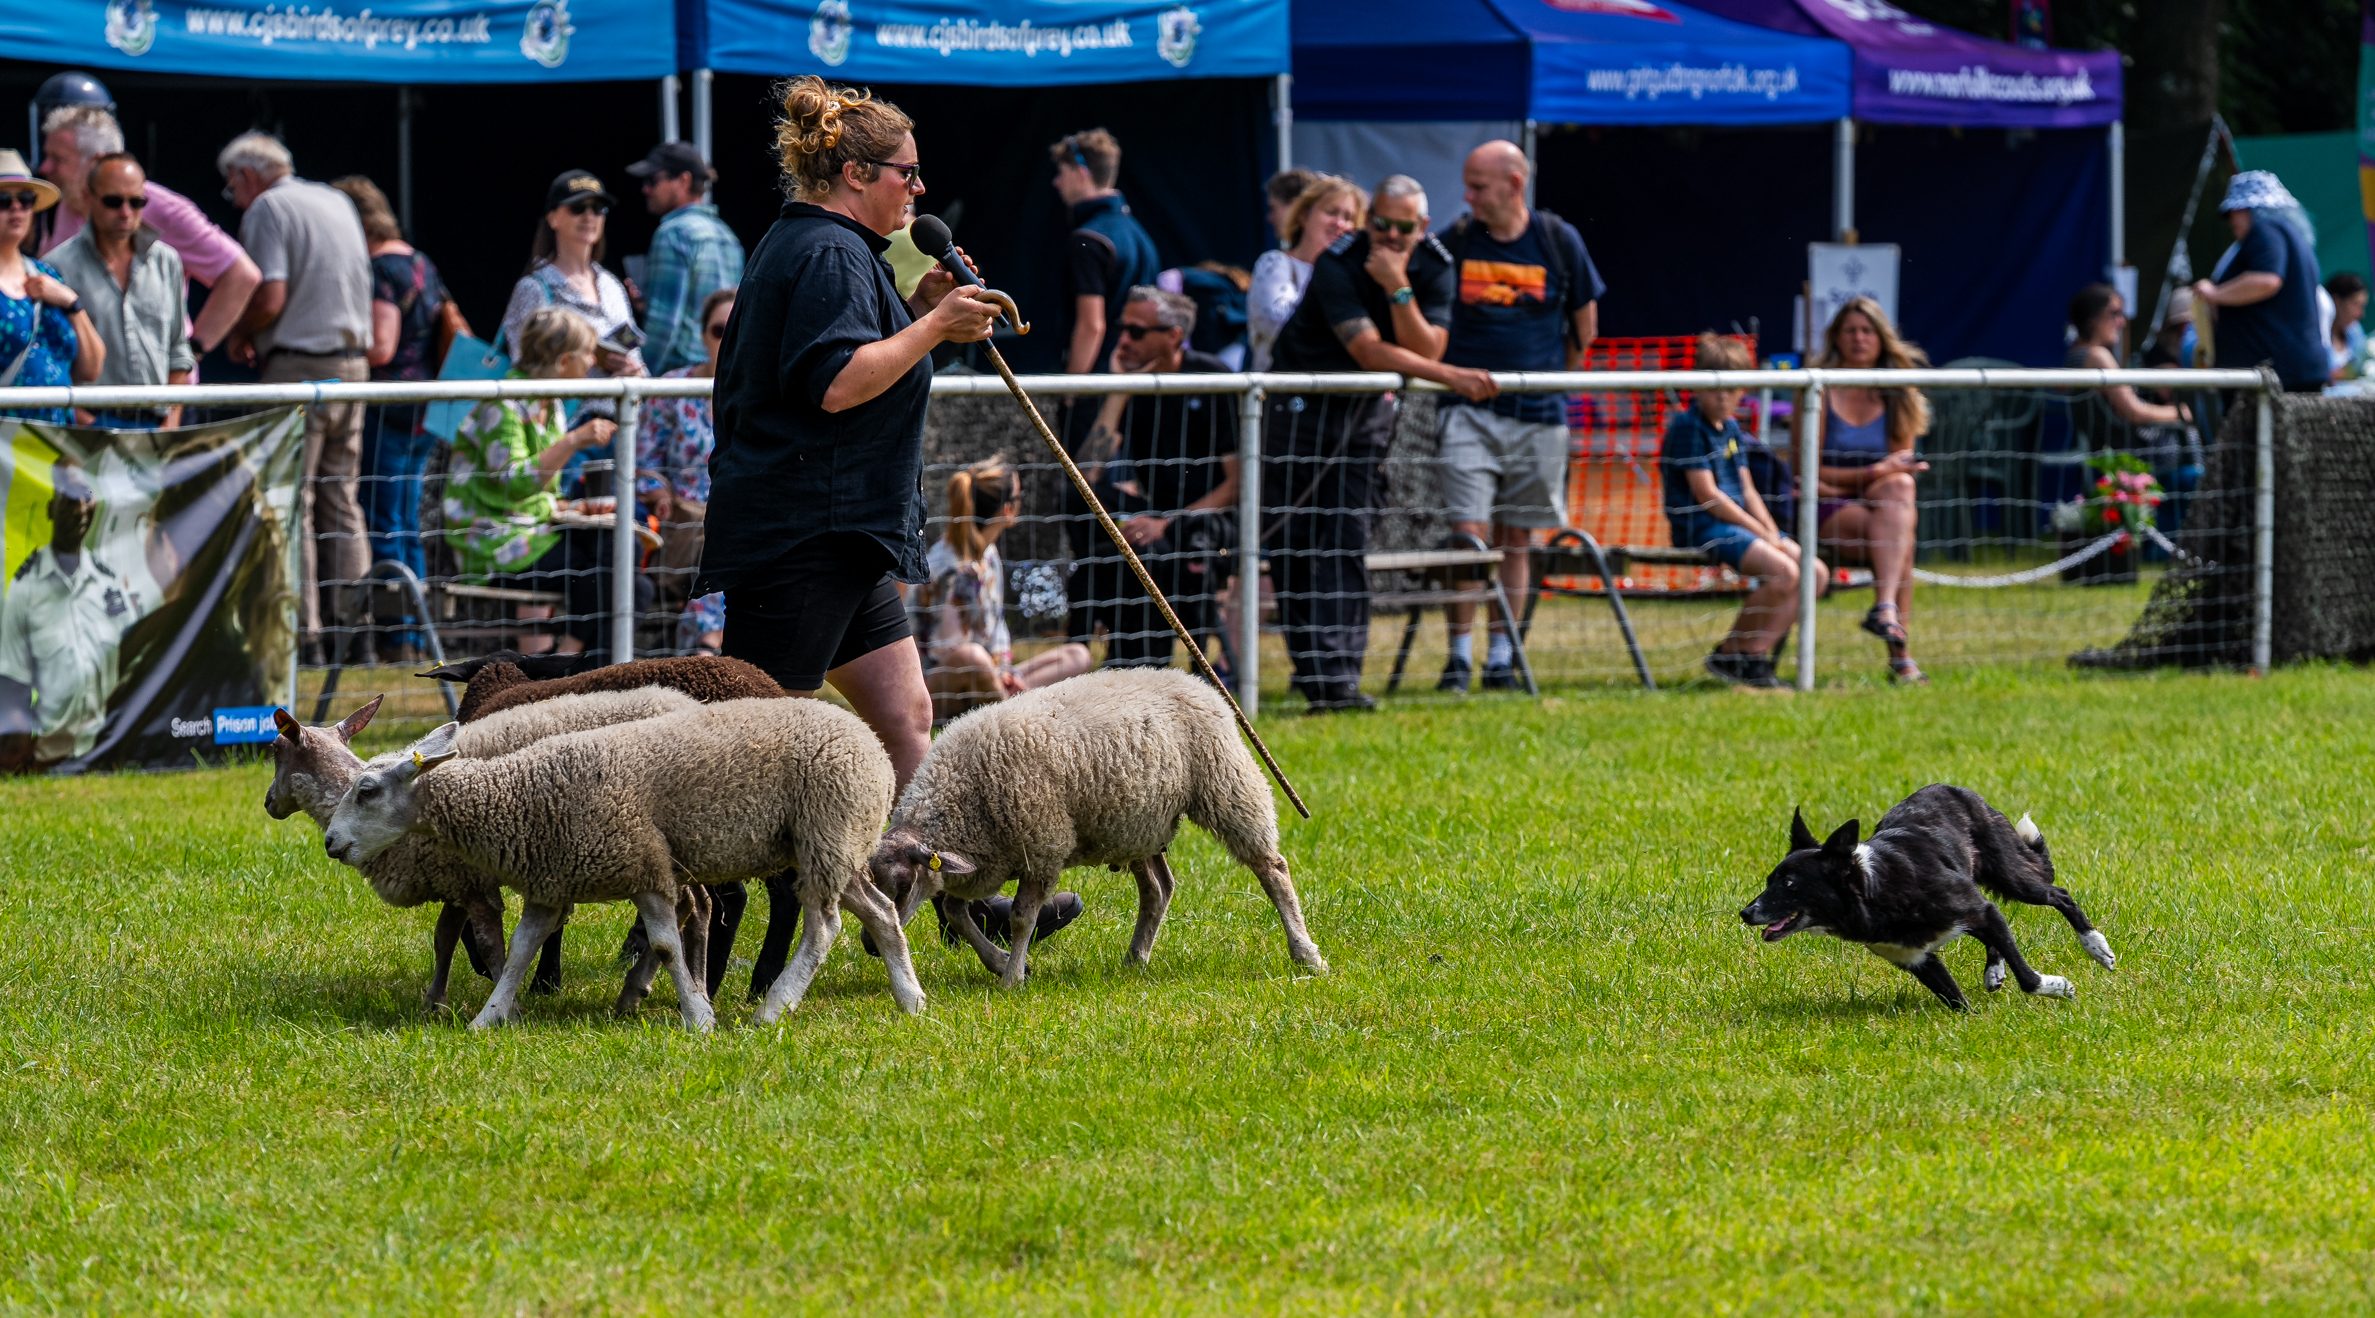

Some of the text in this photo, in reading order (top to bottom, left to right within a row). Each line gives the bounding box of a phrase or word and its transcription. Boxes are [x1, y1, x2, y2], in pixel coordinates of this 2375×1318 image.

[188, 4, 489, 49] www.cjsbirdsofprey.co.uk
[877, 18, 1132, 56] www.cjsbirdsofprey.co.uk
[171, 713, 278, 738] Search Prison job
